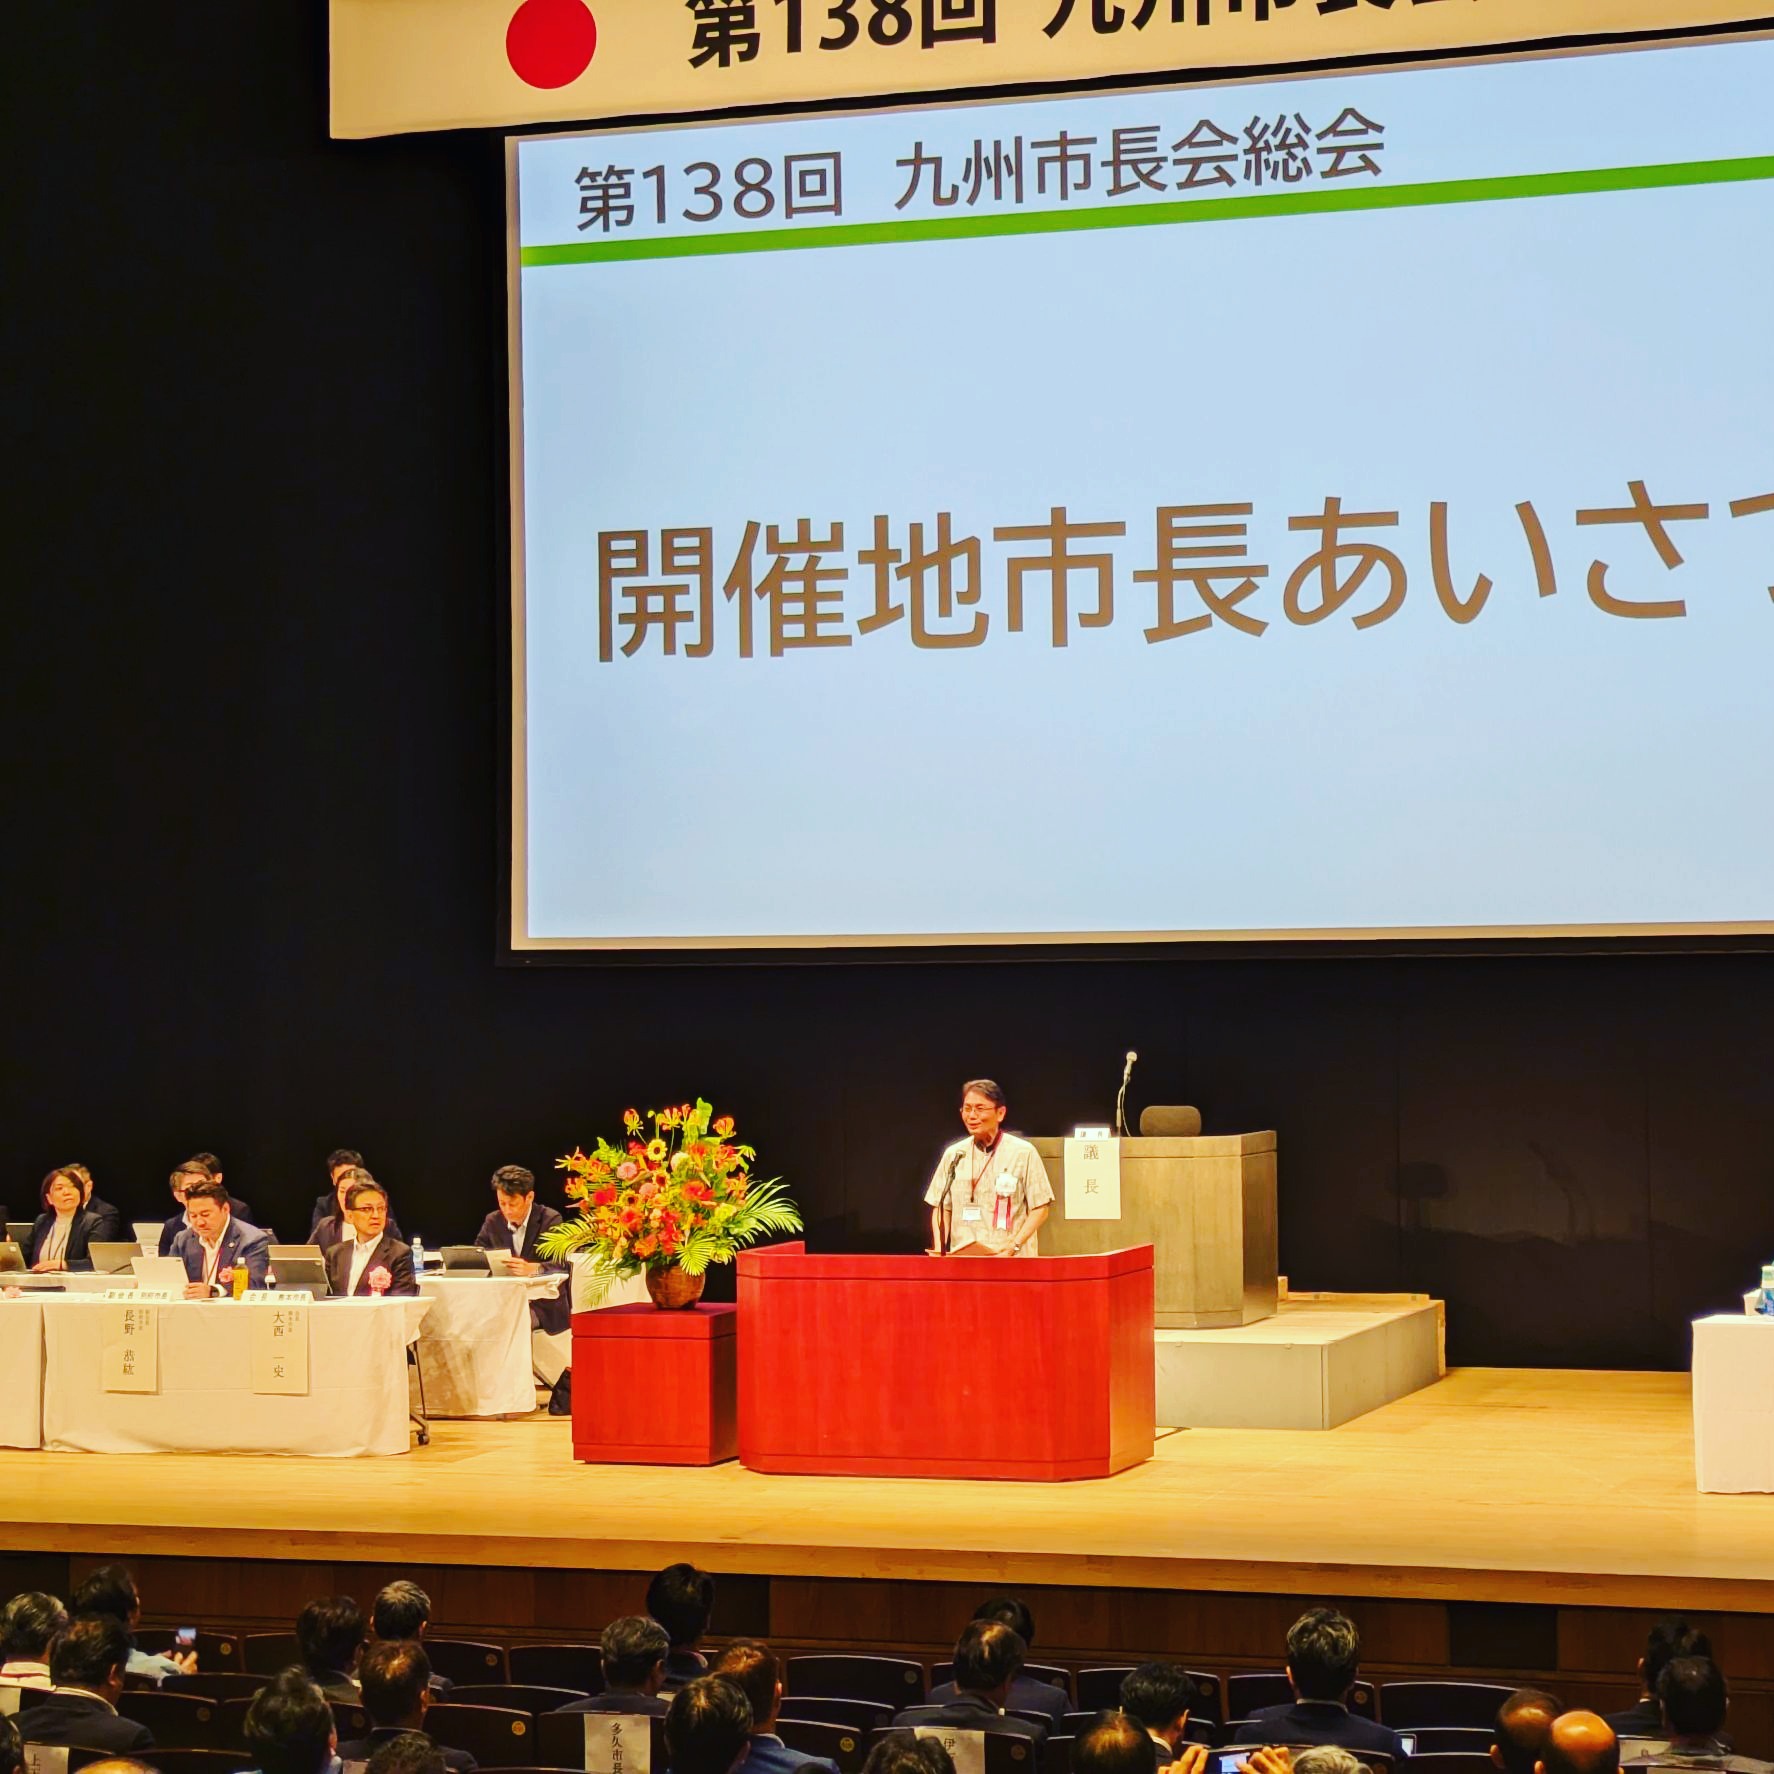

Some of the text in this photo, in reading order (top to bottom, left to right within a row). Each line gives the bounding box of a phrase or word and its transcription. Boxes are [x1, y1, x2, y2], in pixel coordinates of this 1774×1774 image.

[687, 0, 997, 69] 第138回
[574, 107, 1386, 230] 第138回 九州市長会総会
[1083, 1144, 1100, 1194] 議長
[272, 1311, 285, 1378] 大西 一史
[611, 1722, 623, 1774] 多久市長
